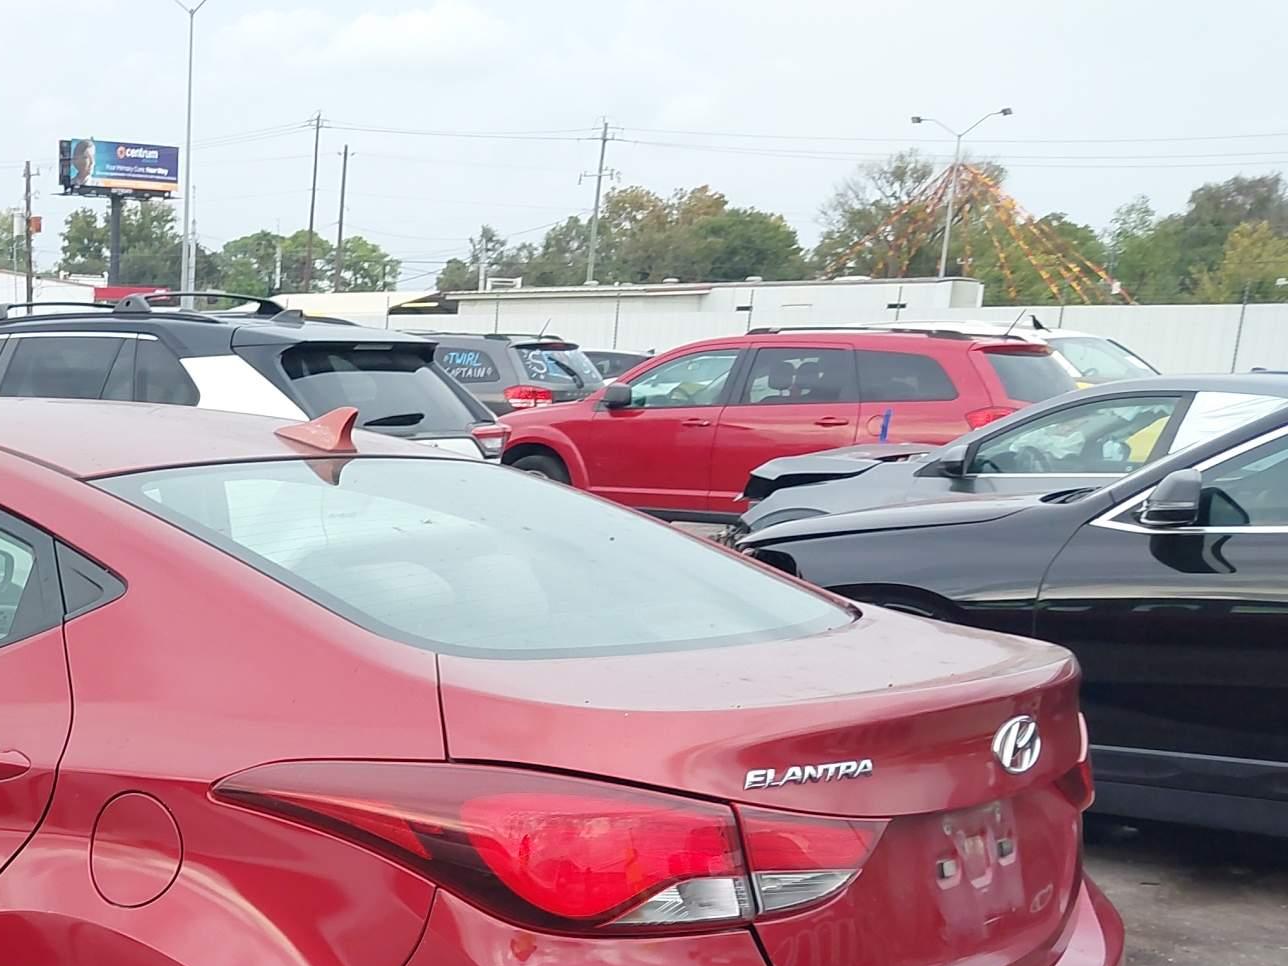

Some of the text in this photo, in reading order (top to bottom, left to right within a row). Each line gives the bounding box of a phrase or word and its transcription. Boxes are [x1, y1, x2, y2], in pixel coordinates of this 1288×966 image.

[126, 147, 158, 159] centrum
[448, 352, 482, 366] TWIRL
[744, 759, 873, 790] ELANTRA
